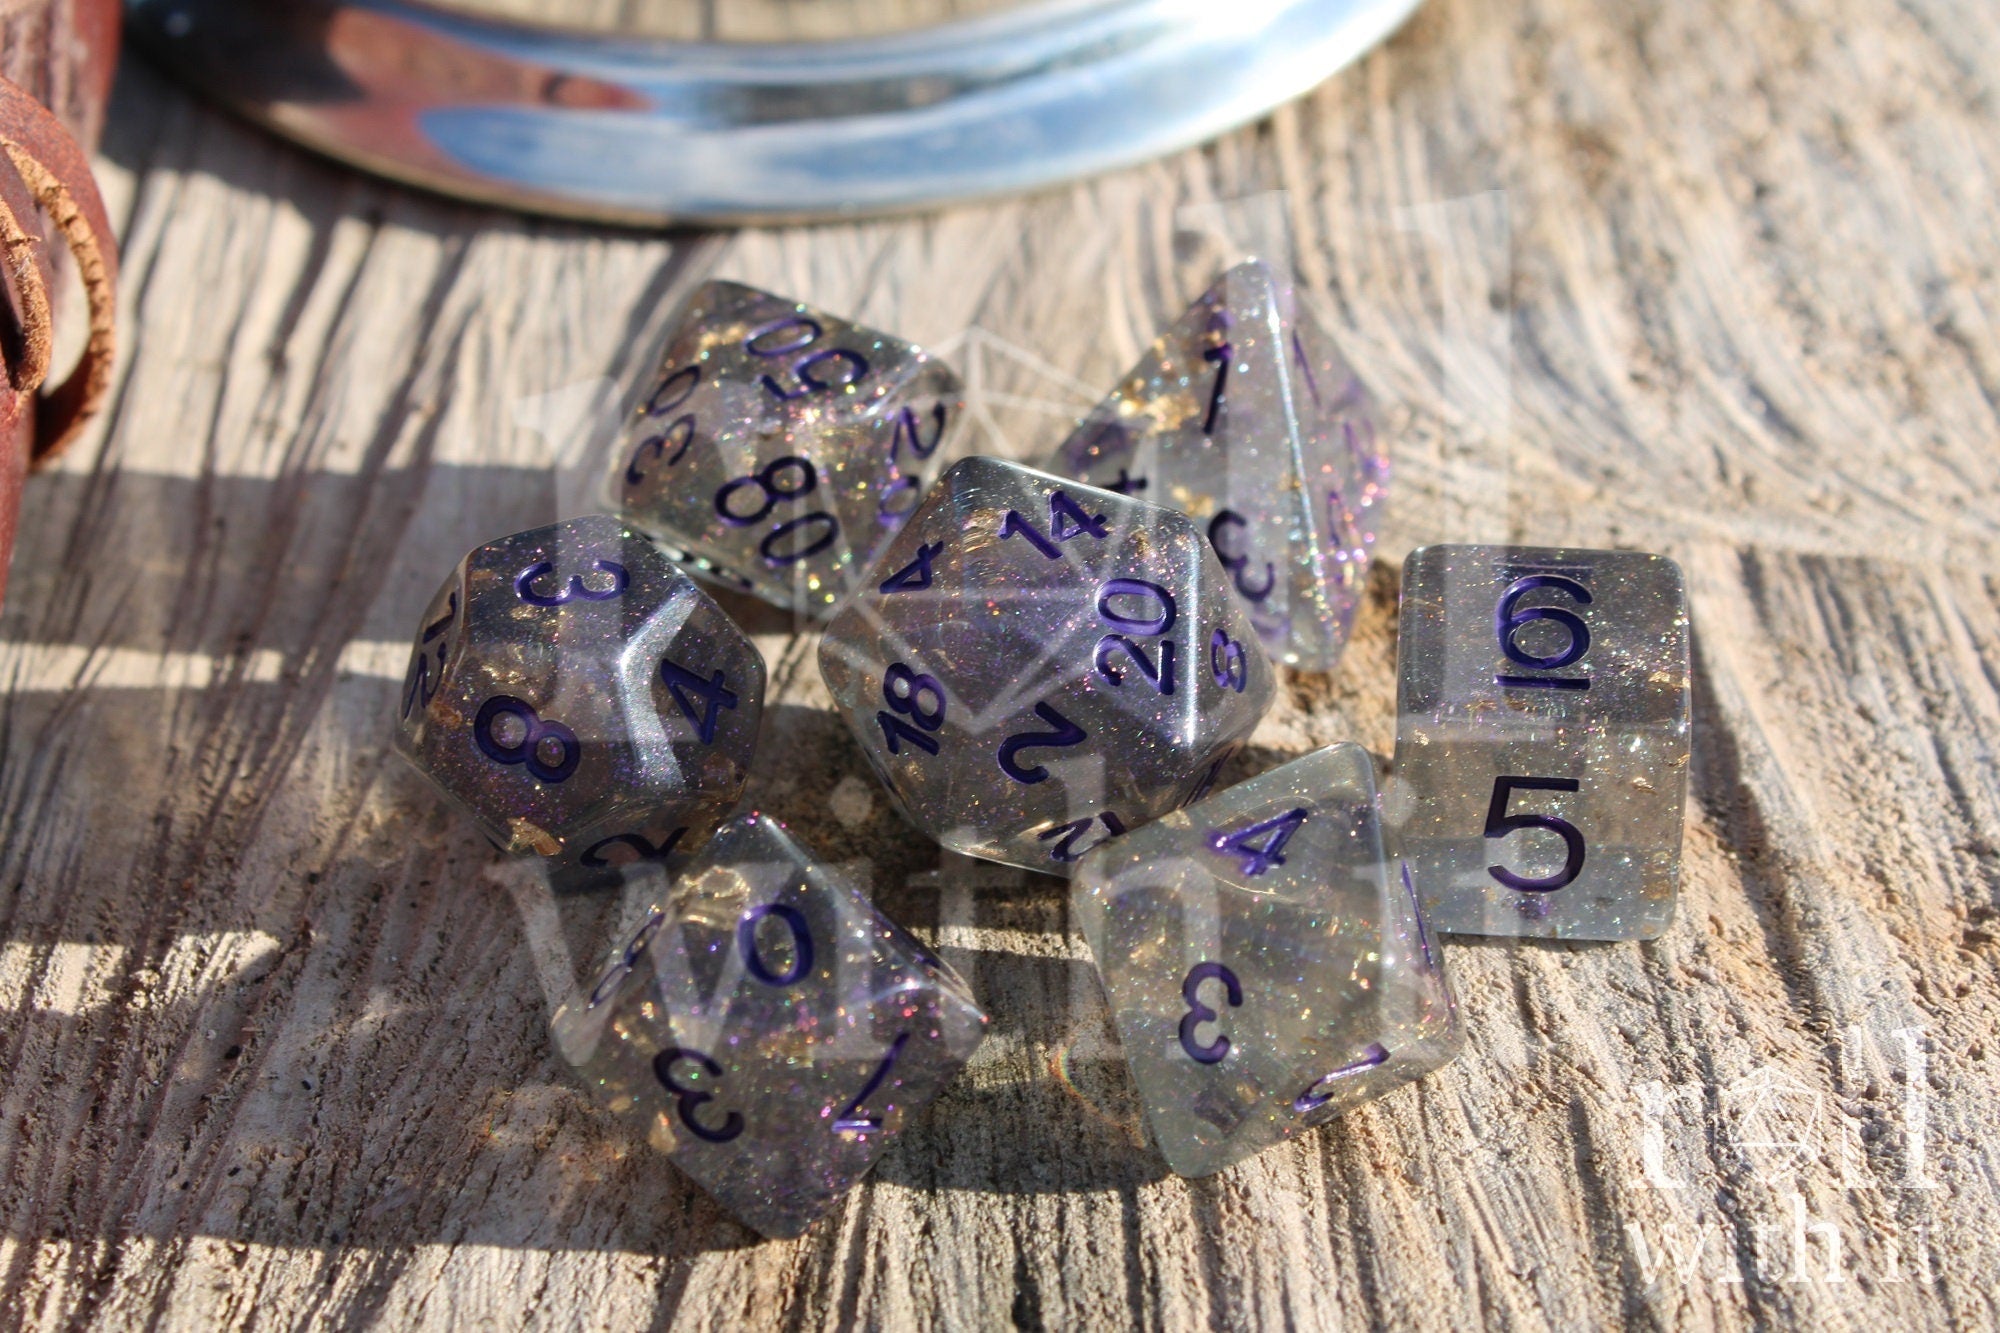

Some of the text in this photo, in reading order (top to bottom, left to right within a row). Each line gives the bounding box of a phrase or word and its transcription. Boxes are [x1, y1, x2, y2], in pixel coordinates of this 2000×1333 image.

[743, 317, 868, 402] 50
[626, 364, 700, 486] 30
[714, 455, 840, 566] 80
[1000, 490, 1107, 560] 14
[1207, 508, 1275, 602] 3
[513, 560, 631, 607] 3
[879, 540, 944, 594] 4
[1092, 577, 1176, 696] 20
[1209, 628, 1247, 693] 8
[1494, 573, 1593, 690] 6
[474, 695, 581, 784] 8
[661, 658, 738, 746] 4
[877, 662, 946, 756] 18
[998, 701, 1087, 785] 2
[1204, 808, 1309, 877] 4
[1484, 775, 1585, 893] 5
[737, 902, 814, 987] 0
[1179, 961, 1244, 1065] 3
[653, 1047, 745, 1144] 3
